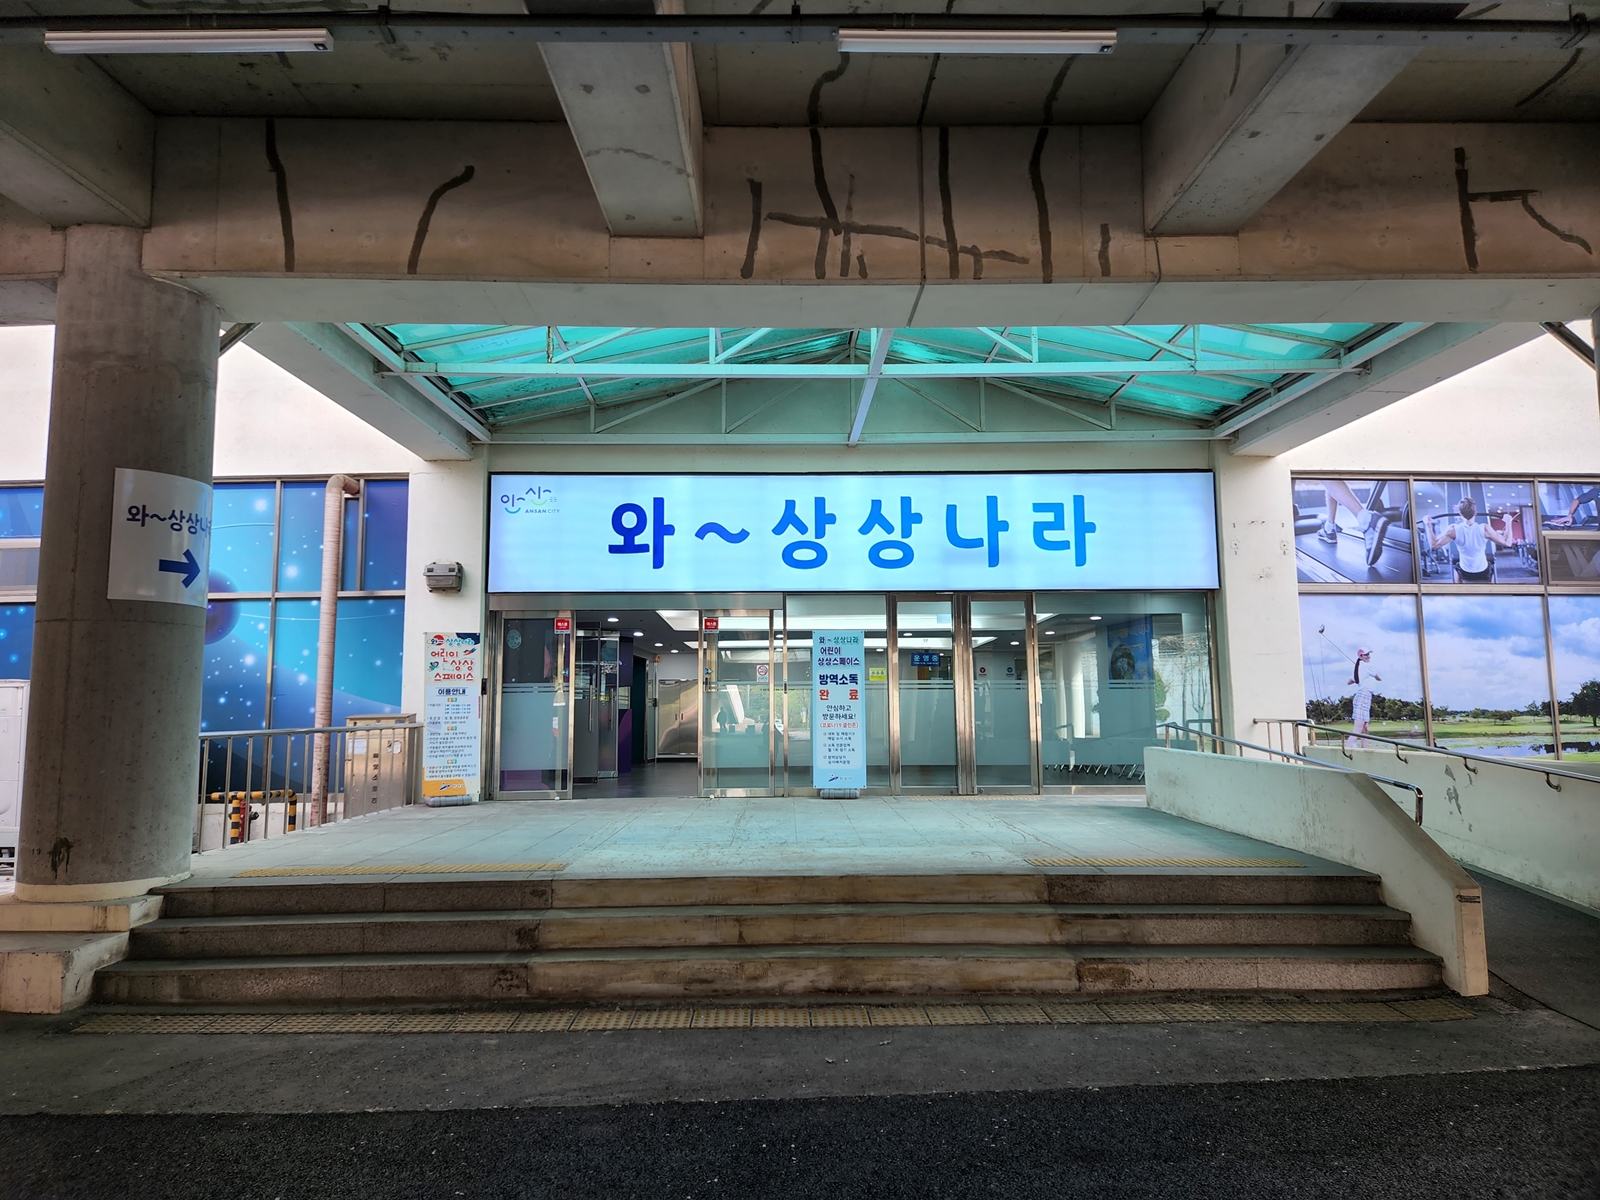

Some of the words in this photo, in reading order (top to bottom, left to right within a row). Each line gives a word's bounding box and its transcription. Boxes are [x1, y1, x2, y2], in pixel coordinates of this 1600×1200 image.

[820, 646, 841, 655] 어린이
[430, 648, 459, 663] 어린이
[450, 659, 475, 672] 상상
[818, 657, 860, 666] 상상스페이스
[434, 672, 474, 682] 스페이스
[819, 673, 859, 686] 방역소독
[437, 688, 467, 696] 이용안내
[826, 704, 852, 712] 안심하고
